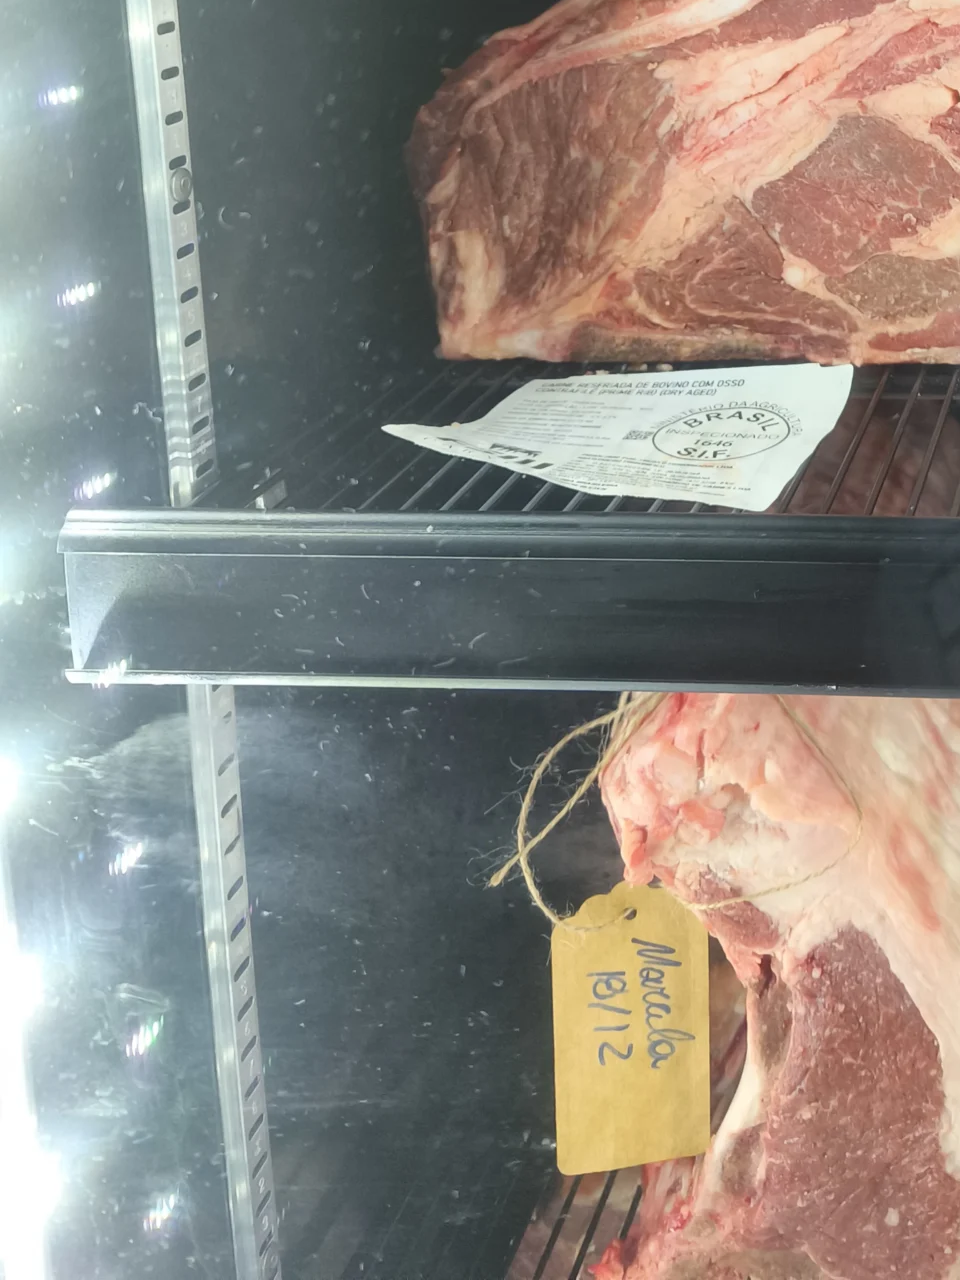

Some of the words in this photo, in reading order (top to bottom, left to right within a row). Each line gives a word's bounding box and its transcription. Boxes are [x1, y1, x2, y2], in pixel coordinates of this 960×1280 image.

[652, 380, 688, 388] BOVINO
[718, 379, 745, 387] OSSO
[683, 411, 780, 432] BRASIL
[665, 428, 780, 440] INSPECIONADO
[694, 439, 734, 447] 1646
